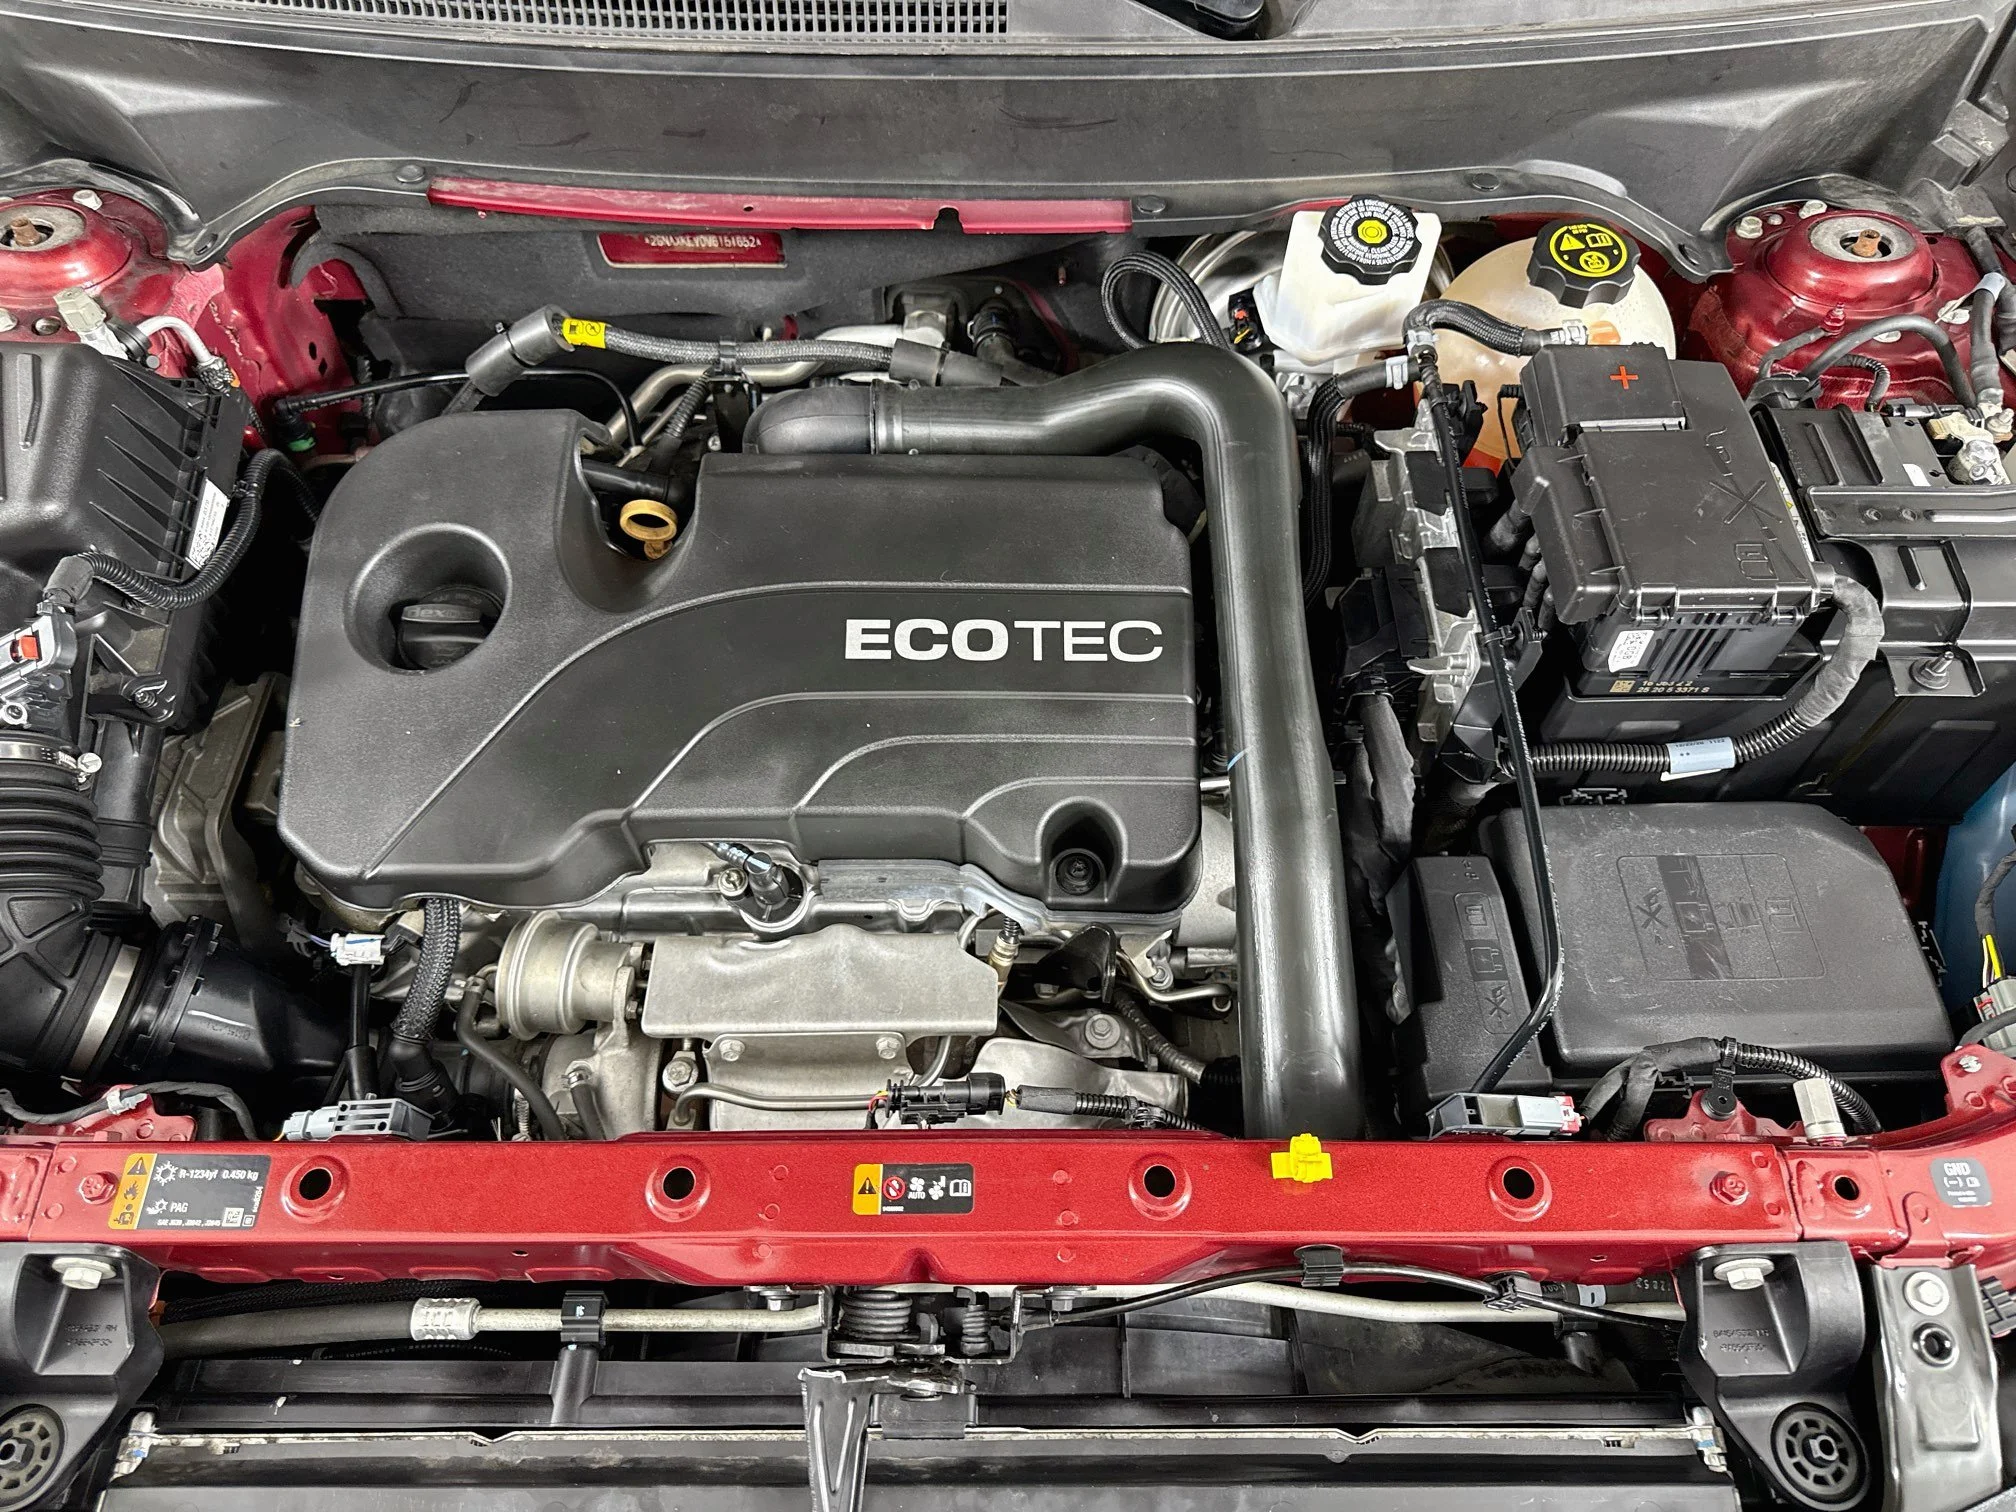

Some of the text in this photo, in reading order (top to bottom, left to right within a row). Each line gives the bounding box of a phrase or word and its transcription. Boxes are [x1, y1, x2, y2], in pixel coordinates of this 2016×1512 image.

[845, 618, 1163, 662] ECOTEC
[179, 1169, 259, 1182] R-1234yf 0.450 kg
[1944, 1162, 1970, 1176] GND
[908, 1191, 926, 1200] AUTO
[170, 1202, 188, 1213] PAG
